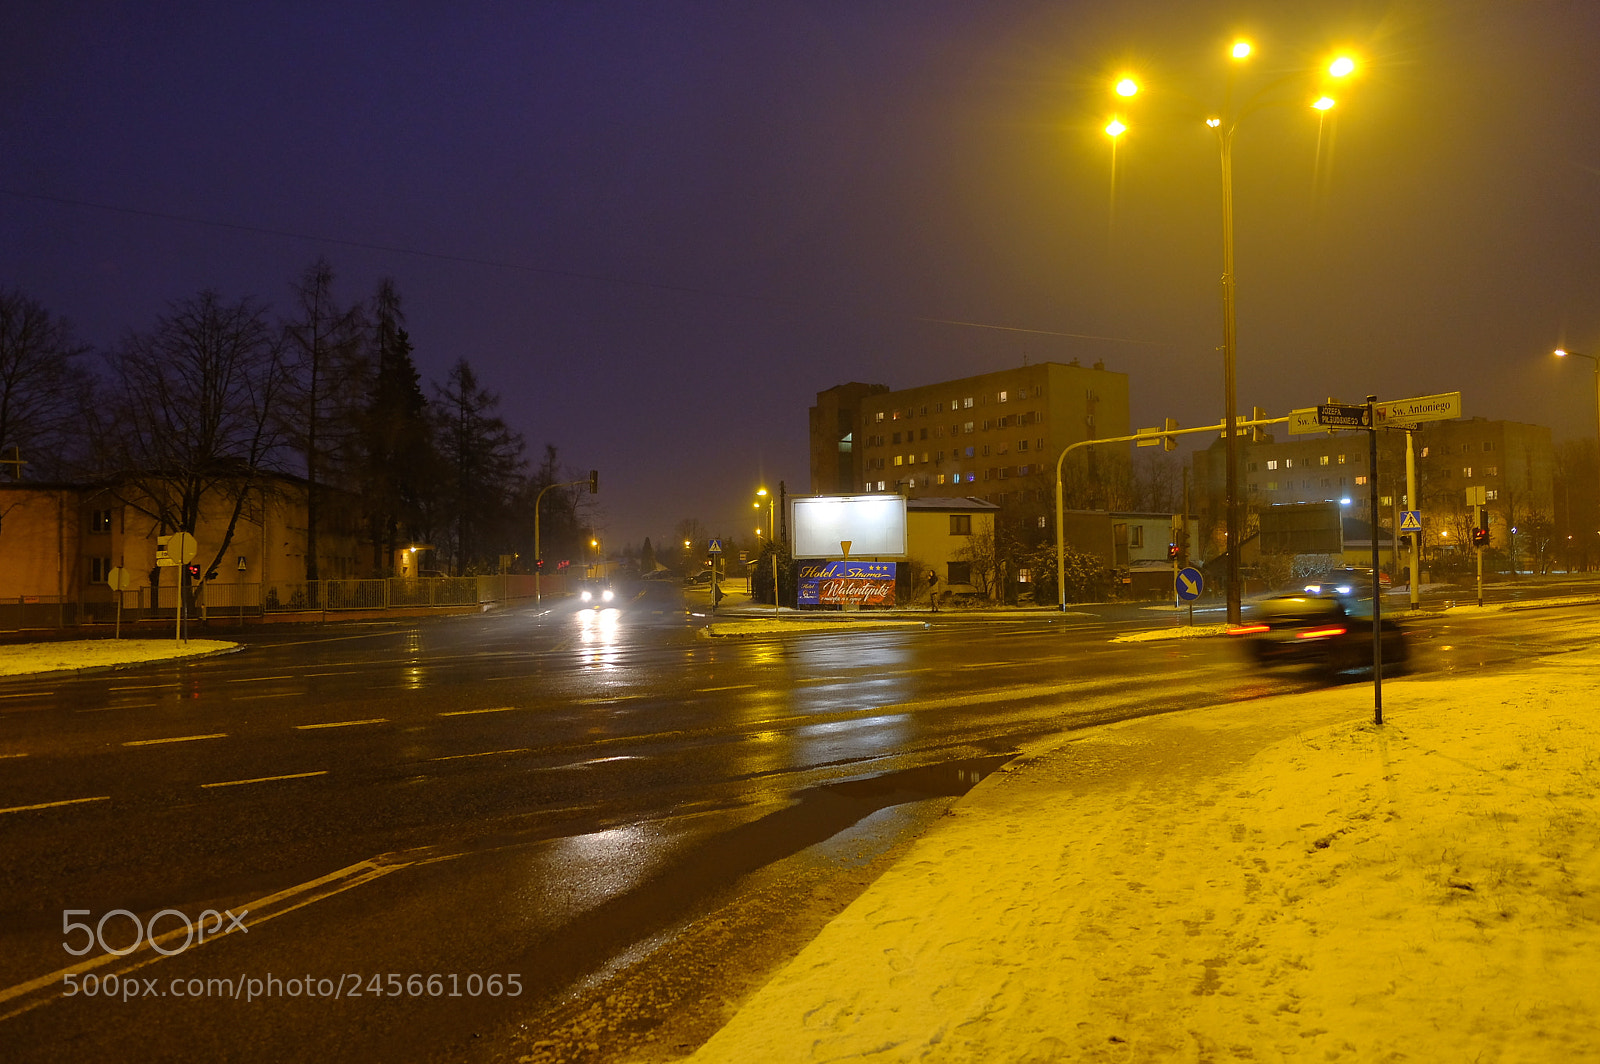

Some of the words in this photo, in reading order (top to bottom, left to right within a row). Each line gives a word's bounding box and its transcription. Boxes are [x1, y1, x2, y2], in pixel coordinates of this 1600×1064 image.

[1409, 401, 1451, 414] Antoniego
[799, 564, 838, 578] Hotel
[822, 580, 889, 602] Walentynki
